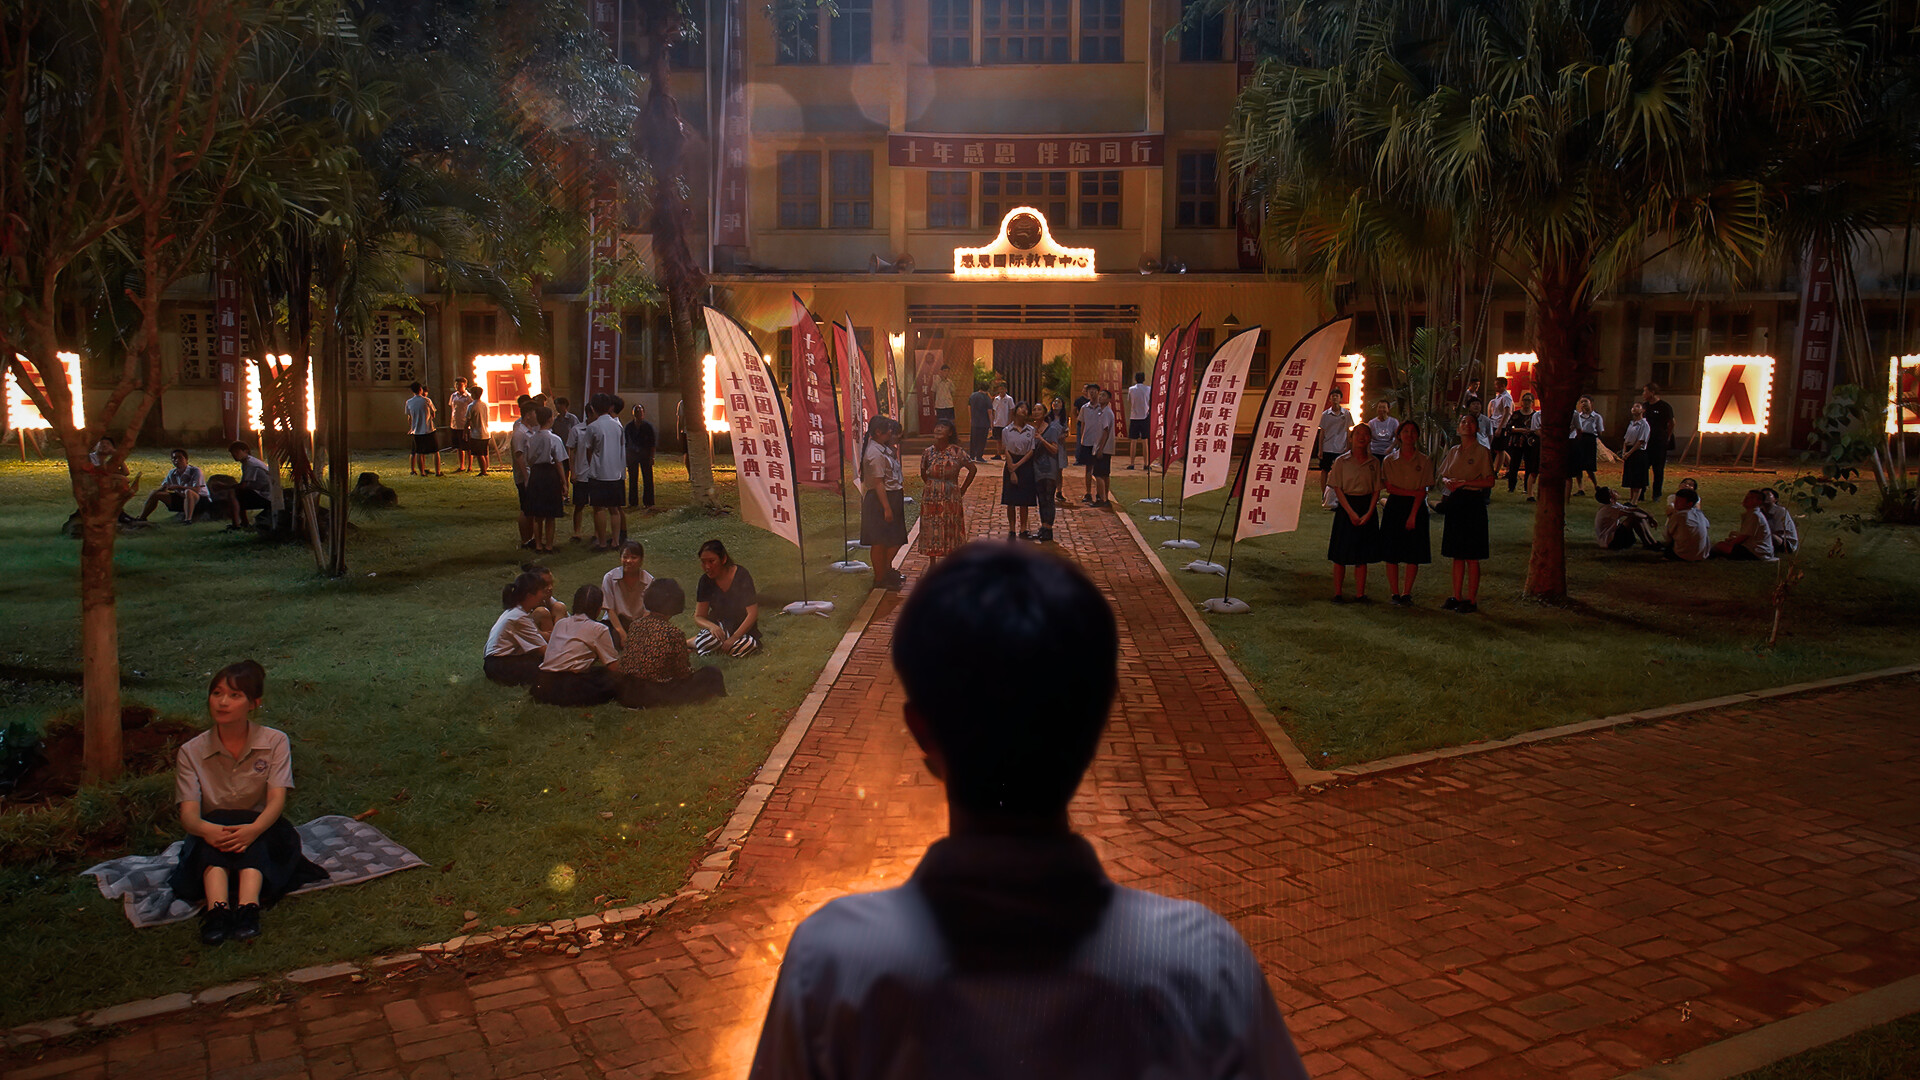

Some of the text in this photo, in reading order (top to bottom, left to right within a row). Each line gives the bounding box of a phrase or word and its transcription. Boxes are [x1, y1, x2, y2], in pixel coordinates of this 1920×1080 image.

[902, 140, 1152, 165] 十年感恩 伴你同行
[1190, 359, 1228, 485] 感恩国际教育中心
[1213, 375, 1241, 453] 十周年庆典
[1248, 359, 1306, 525] 感恩国际教育中心
[1280, 381, 1322, 485] 十周年庆典
